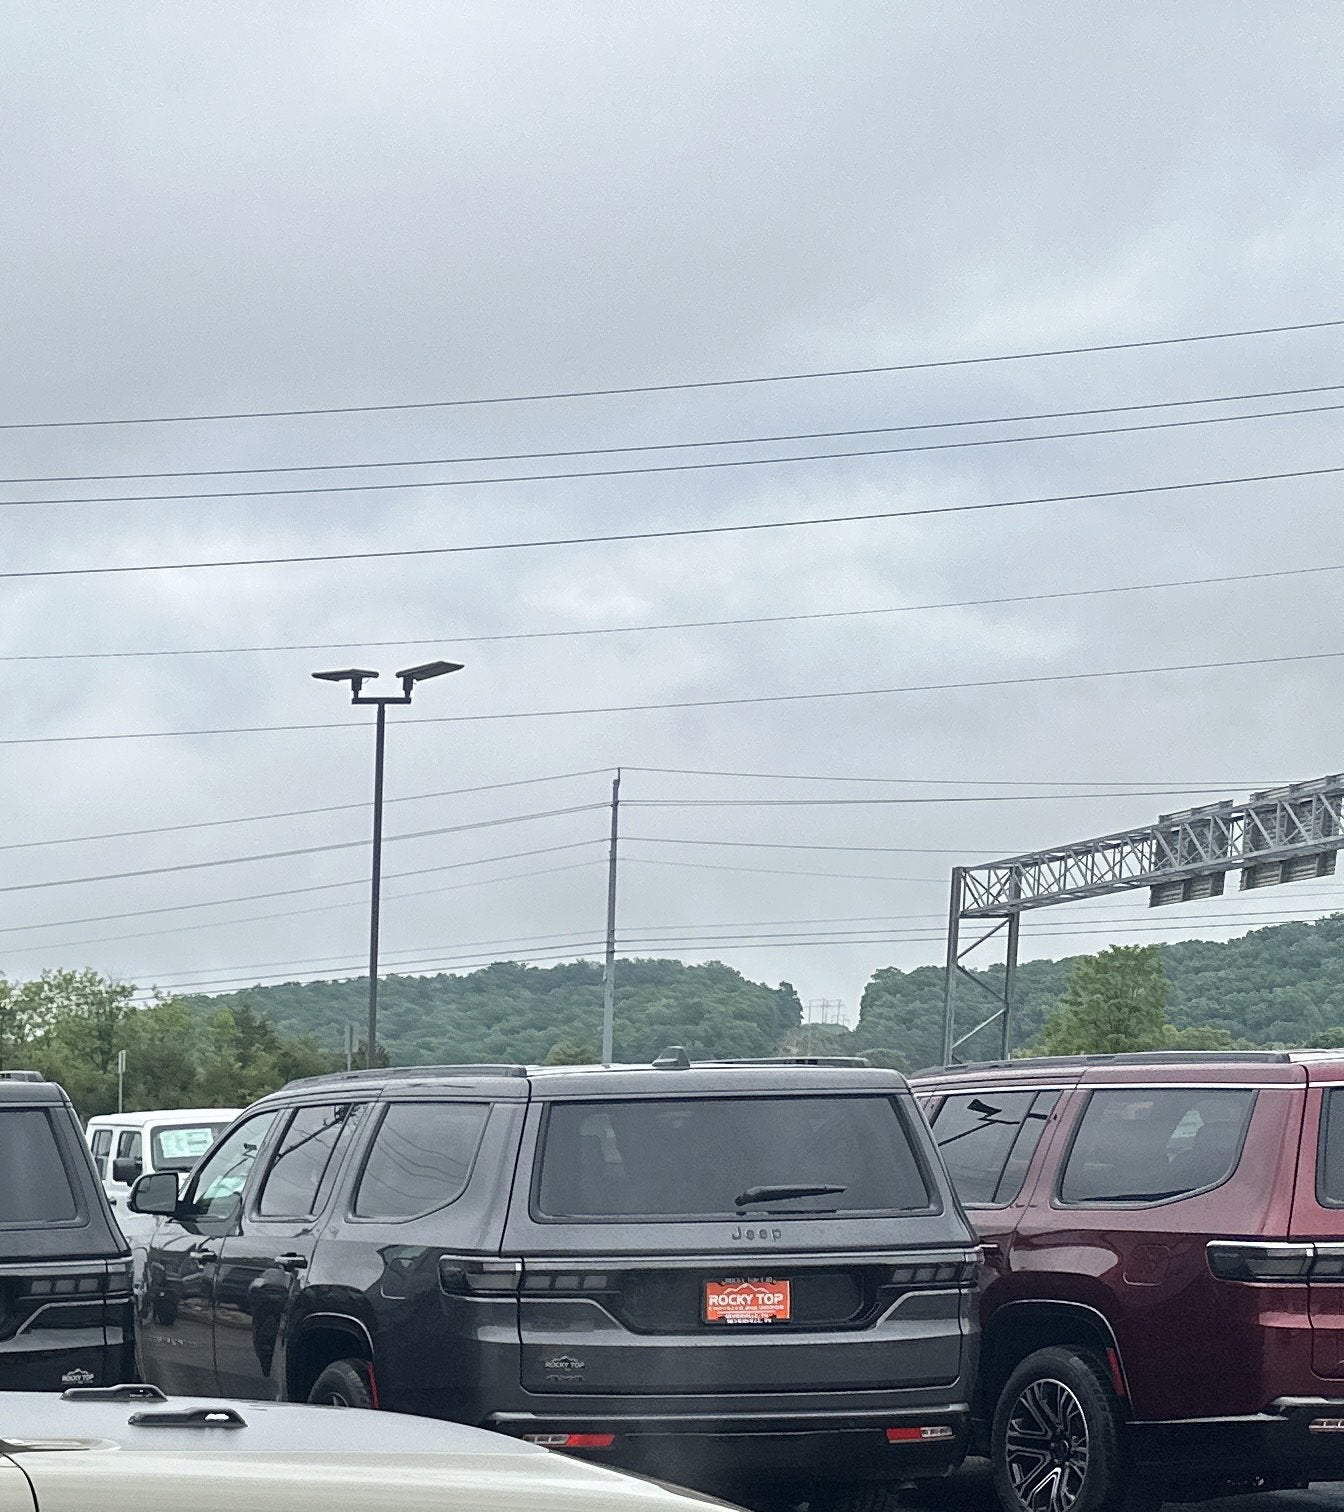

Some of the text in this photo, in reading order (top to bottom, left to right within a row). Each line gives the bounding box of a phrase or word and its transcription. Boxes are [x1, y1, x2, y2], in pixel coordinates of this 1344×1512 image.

[732, 1226, 781, 1242] Jeep
[708, 1293, 784, 1306] ROCKY TOP
